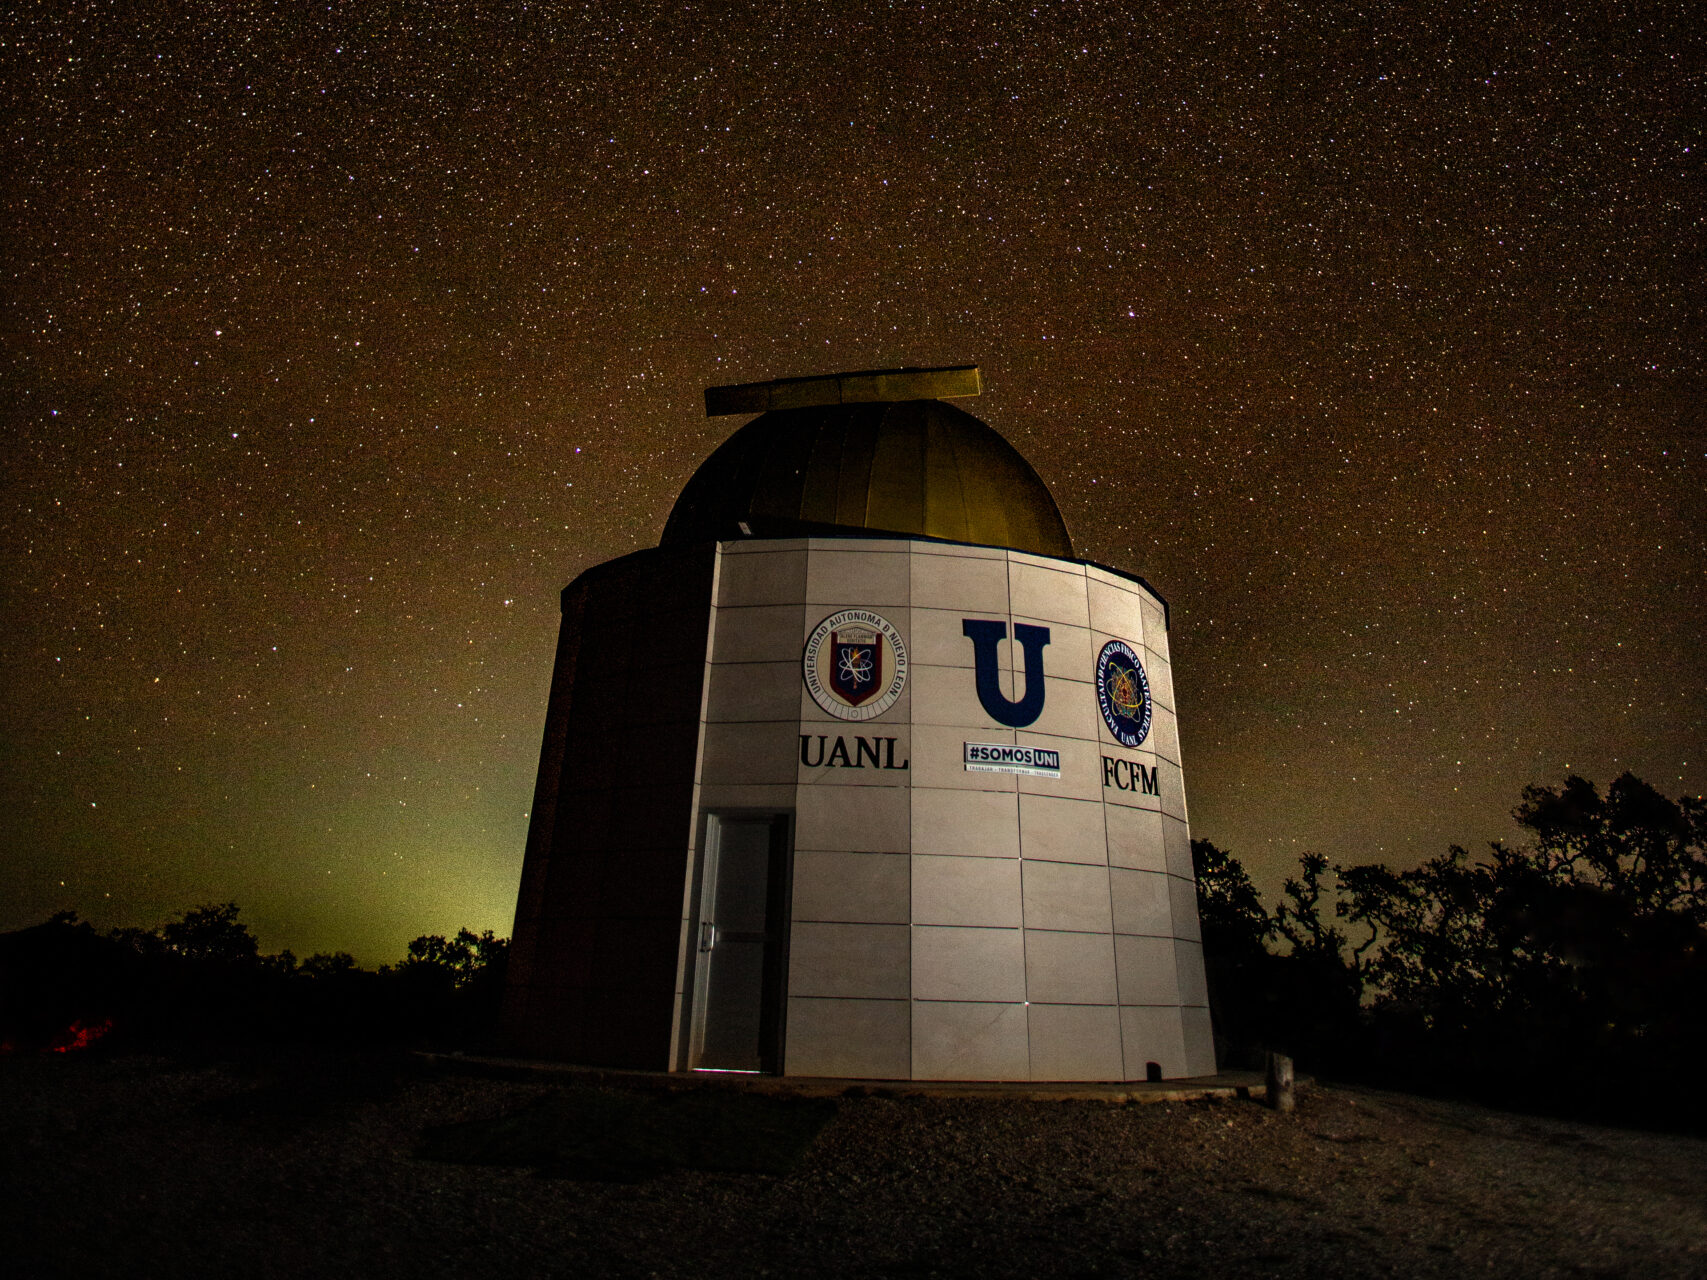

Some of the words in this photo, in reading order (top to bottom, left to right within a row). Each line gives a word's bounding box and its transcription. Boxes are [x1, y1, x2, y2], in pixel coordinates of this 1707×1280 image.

[829, 612, 881, 628] AUTONOMA
[806, 625, 828, 694] UNIVERSIDAD
[889, 632, 905, 666] NUEVO
[1099, 642, 1121, 670] CIENCIAS
[1120, 643, 1140, 669] FISICO
[889, 671, 905, 697] LEON
[962, 619, 1051, 728] U
[800, 735, 909, 770] UANL
[1121, 732, 1138, 746] UANL
[1102, 755, 1161, 797] FCFM
